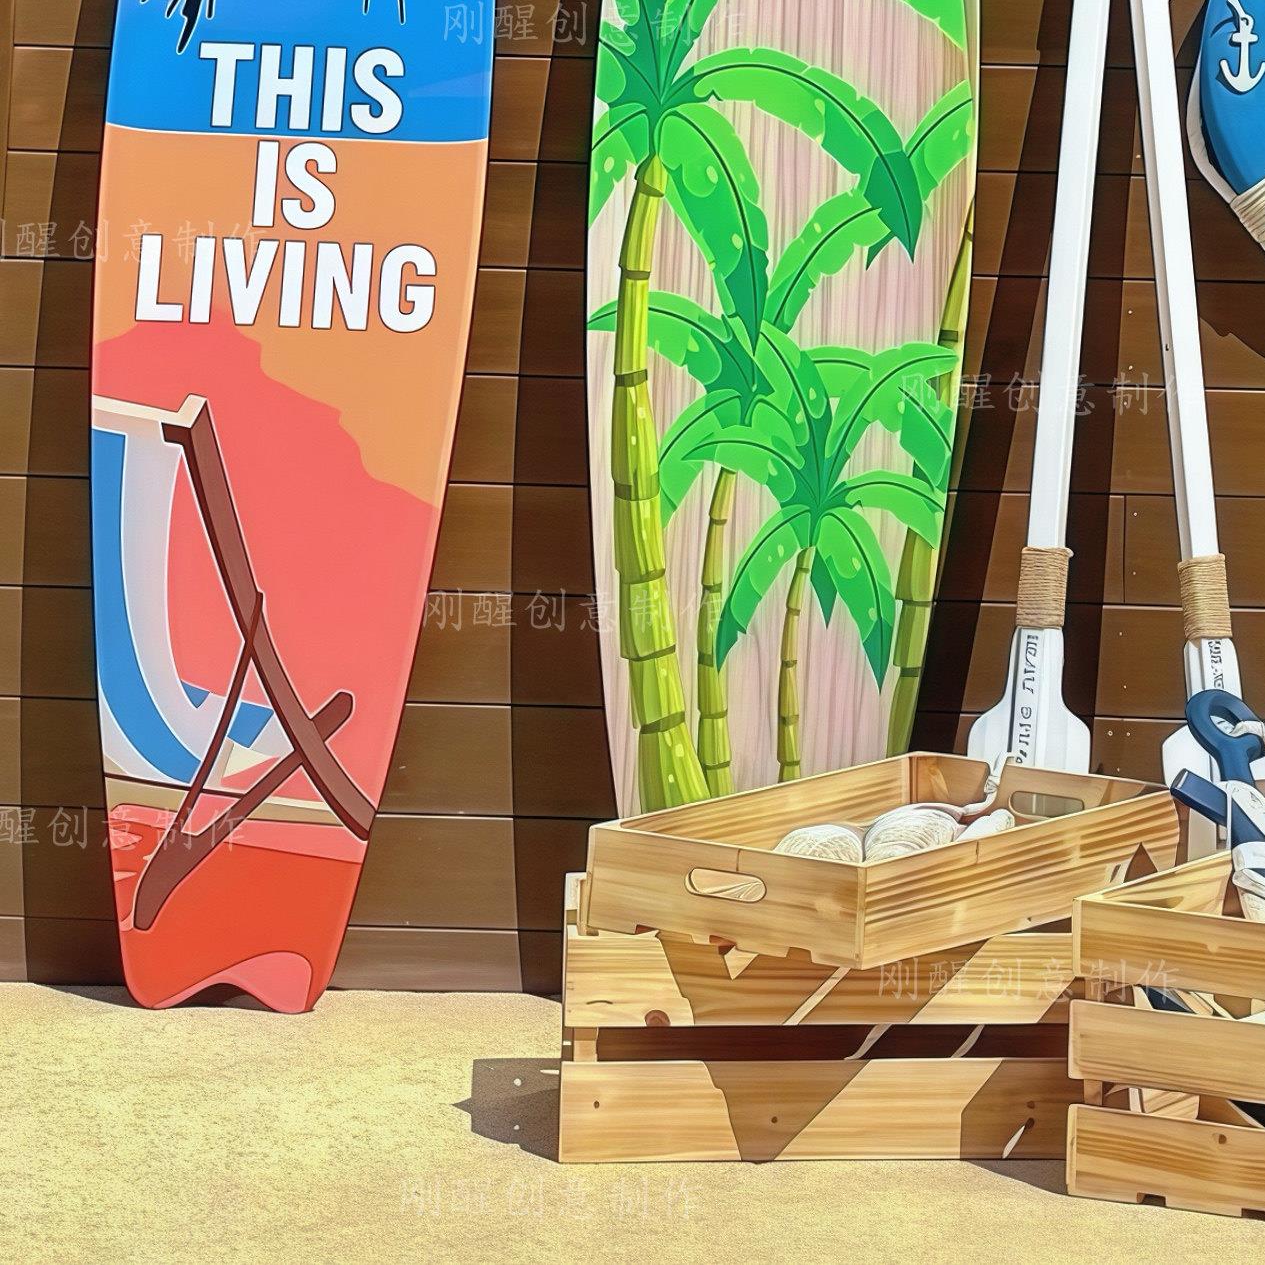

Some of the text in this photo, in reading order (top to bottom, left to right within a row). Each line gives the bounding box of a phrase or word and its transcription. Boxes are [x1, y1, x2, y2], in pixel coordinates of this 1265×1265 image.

[199, 41, 405, 135] THIS
[251, 140, 338, 230] IS
[134, 233, 437, 333] LIVING
